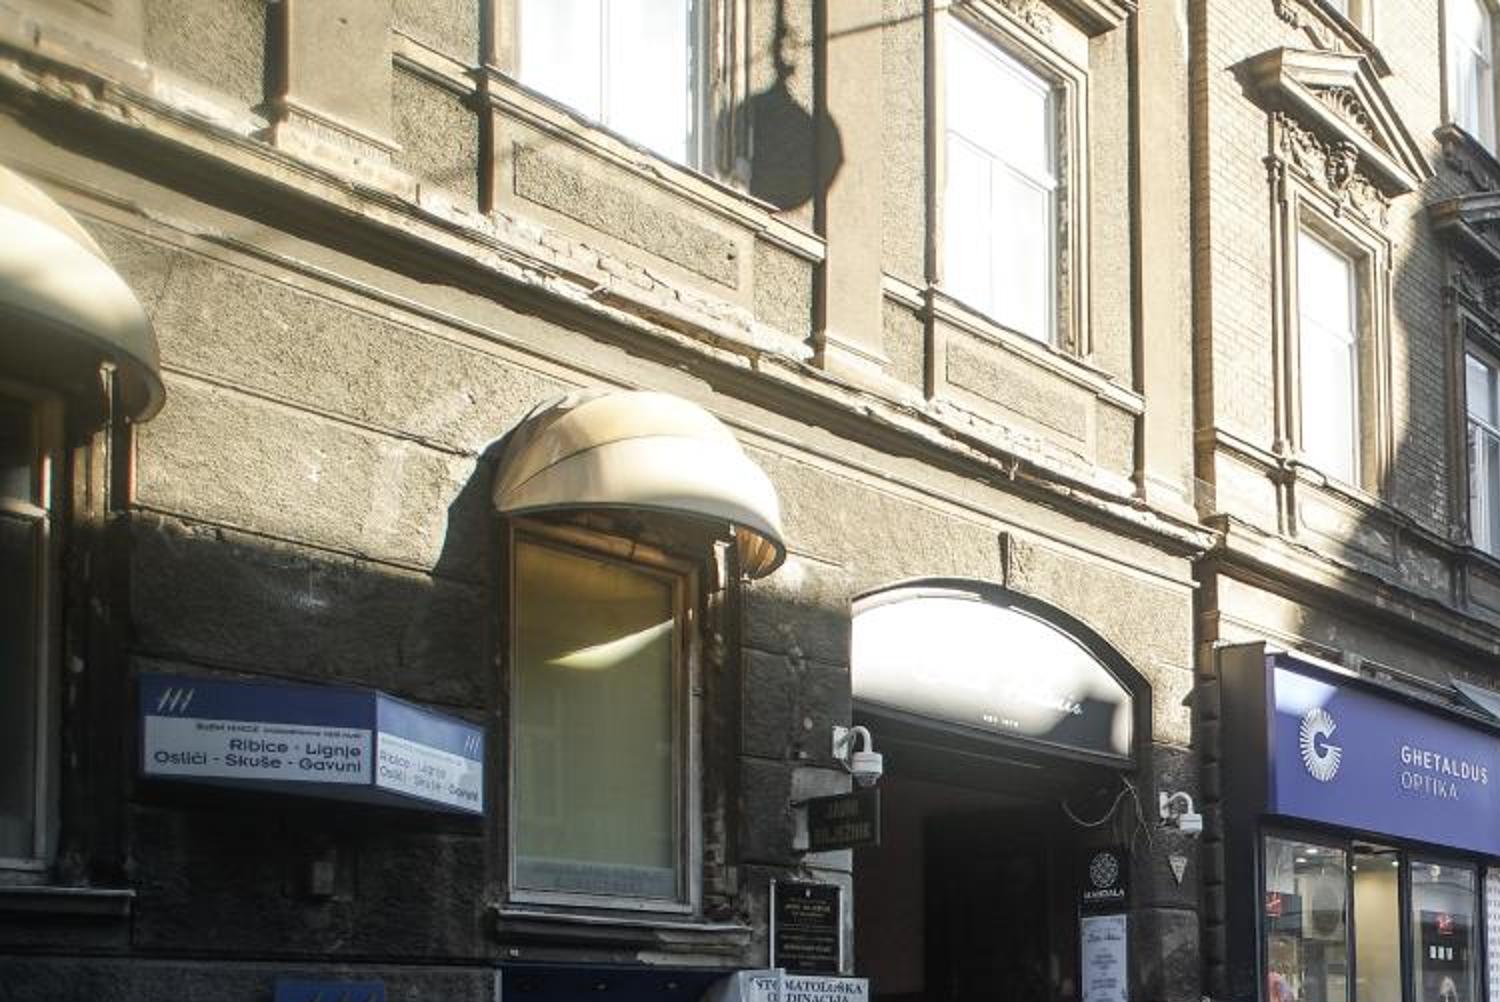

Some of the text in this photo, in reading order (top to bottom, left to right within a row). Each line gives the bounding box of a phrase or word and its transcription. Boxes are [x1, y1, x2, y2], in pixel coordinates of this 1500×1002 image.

[229, 738, 289, 755] Ribice
[305, 743, 362, 760] Lignje
[225, 753, 283, 770] Skuše
[299, 757, 362, 774] Gavuni
[1400, 745, 1489, 785] GHETALDUS
[1401, 772, 1459, 801] OPTIKA
